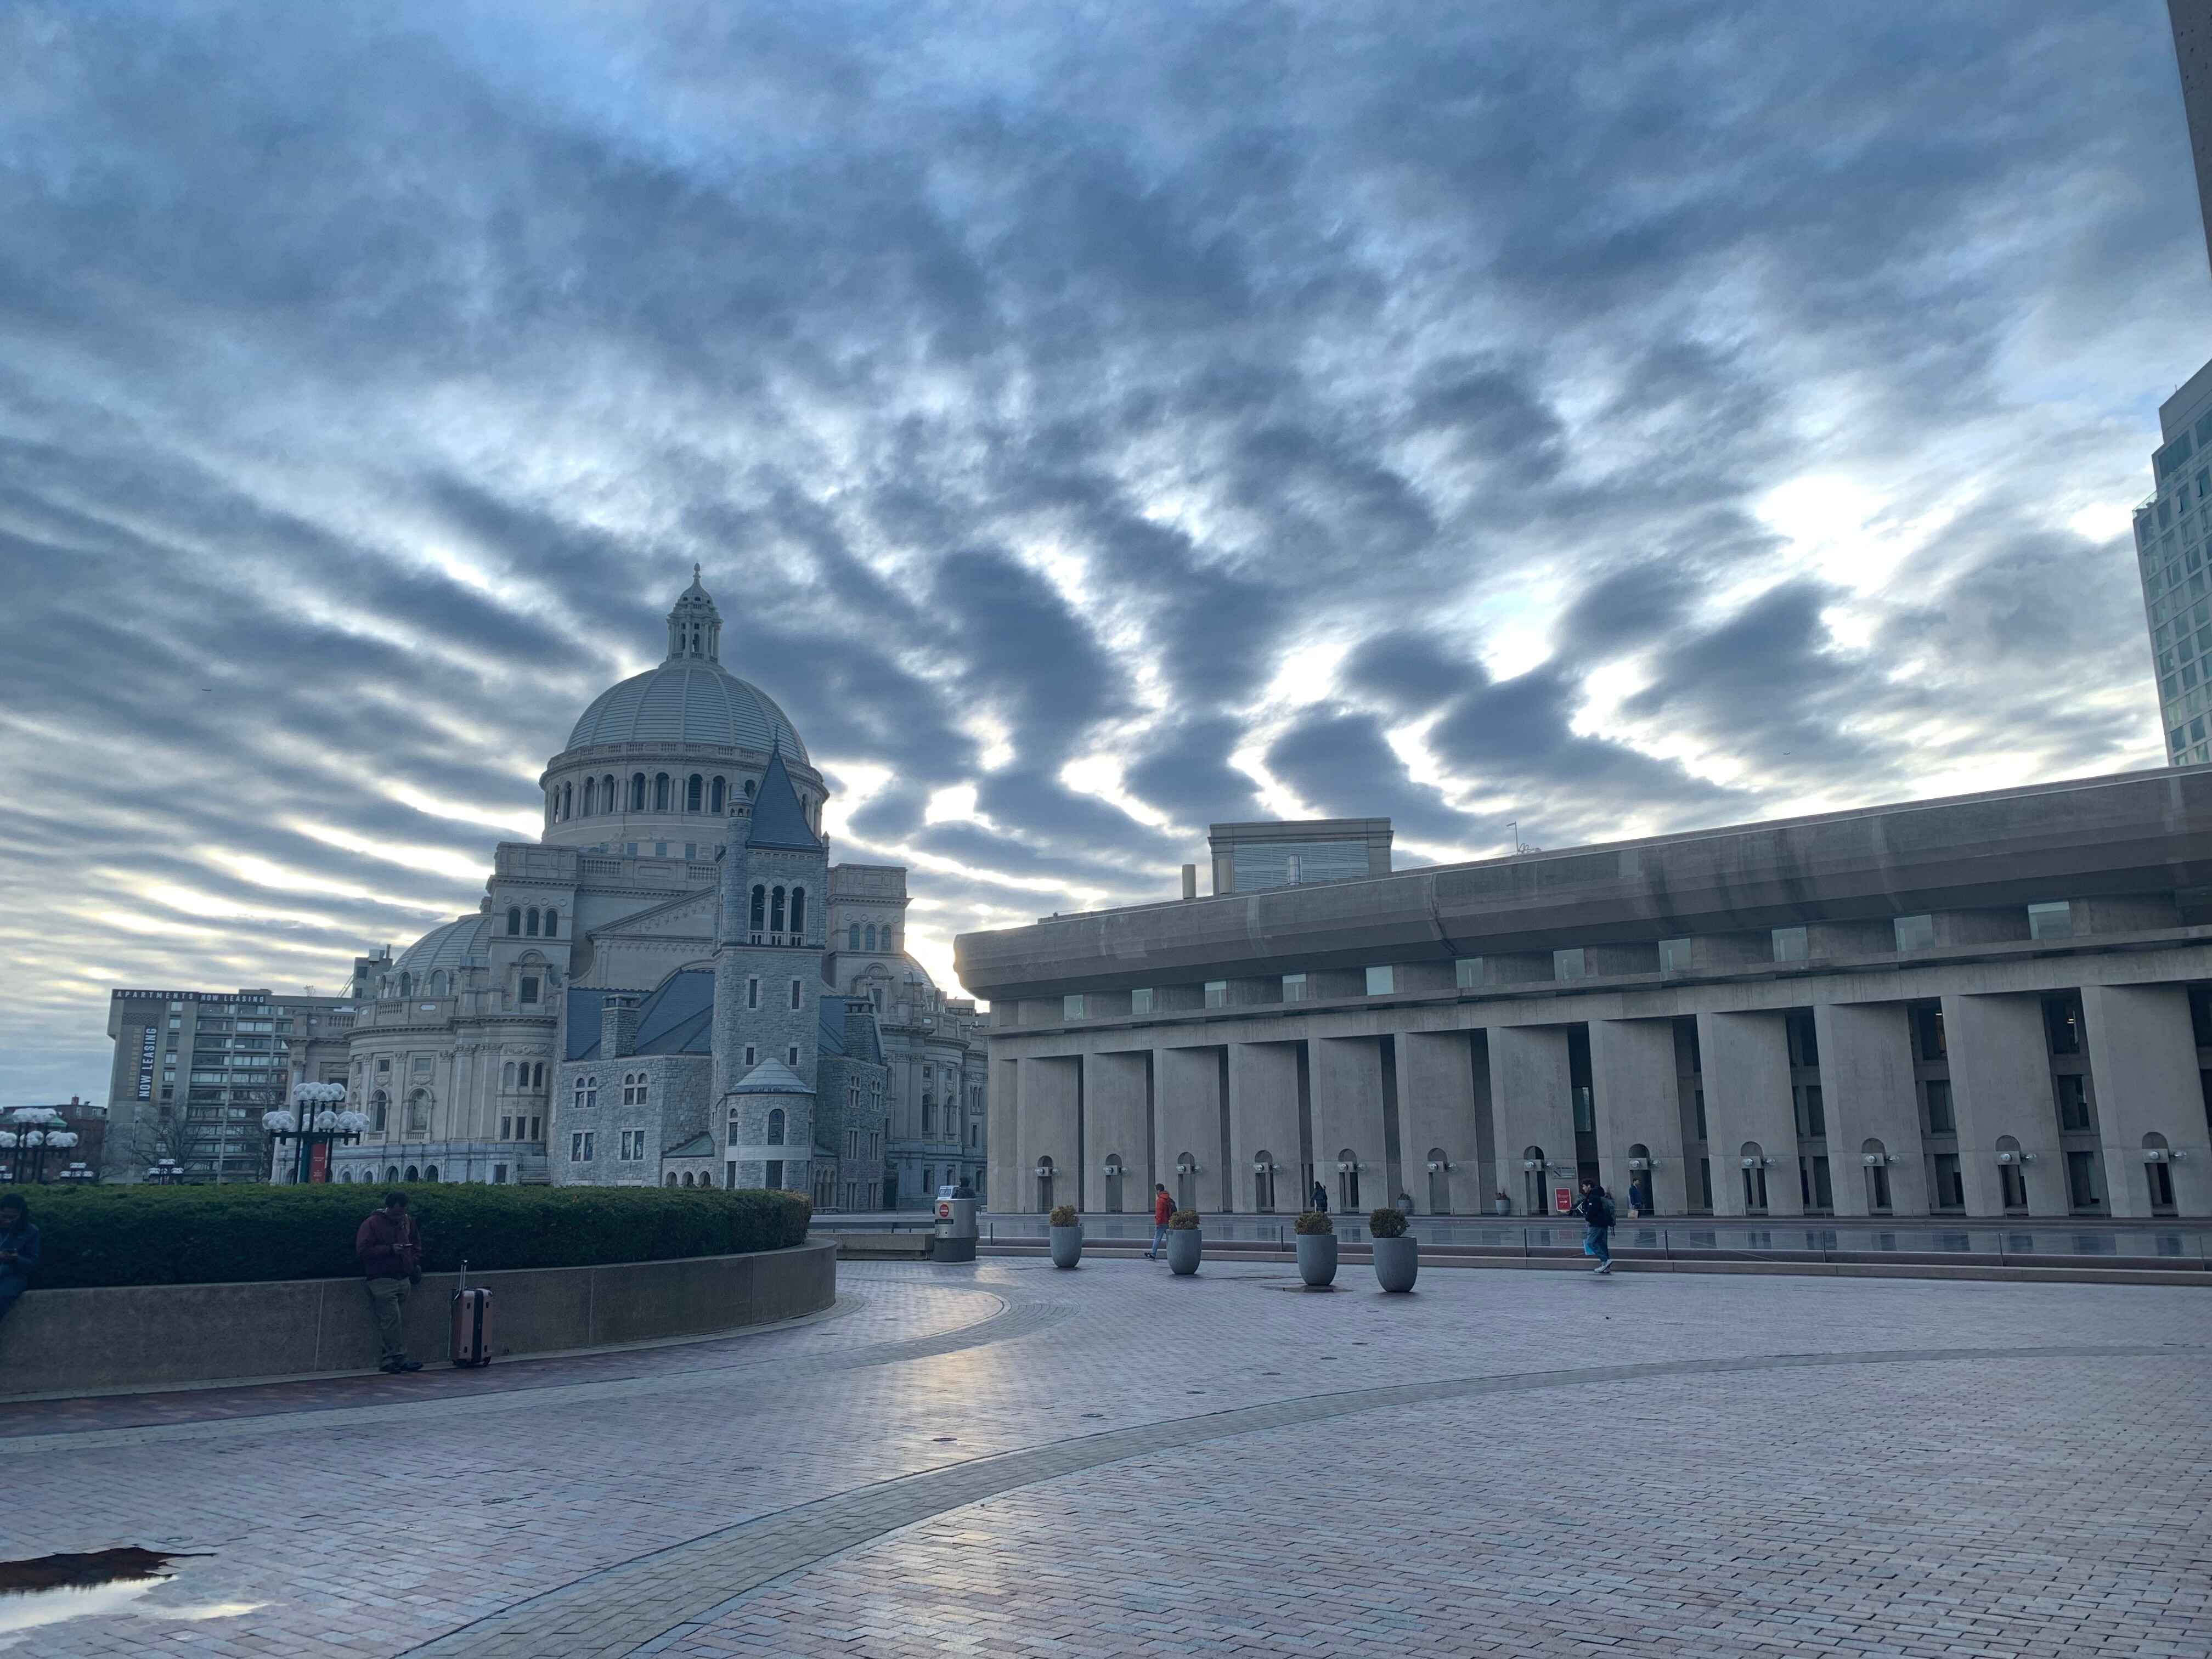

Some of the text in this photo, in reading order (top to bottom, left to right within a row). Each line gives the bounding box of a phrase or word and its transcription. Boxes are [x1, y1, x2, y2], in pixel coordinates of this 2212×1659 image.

[116, 991, 193, 1000] APARTMENTS
[139, 1028, 157, 1097] NOW LEASING
